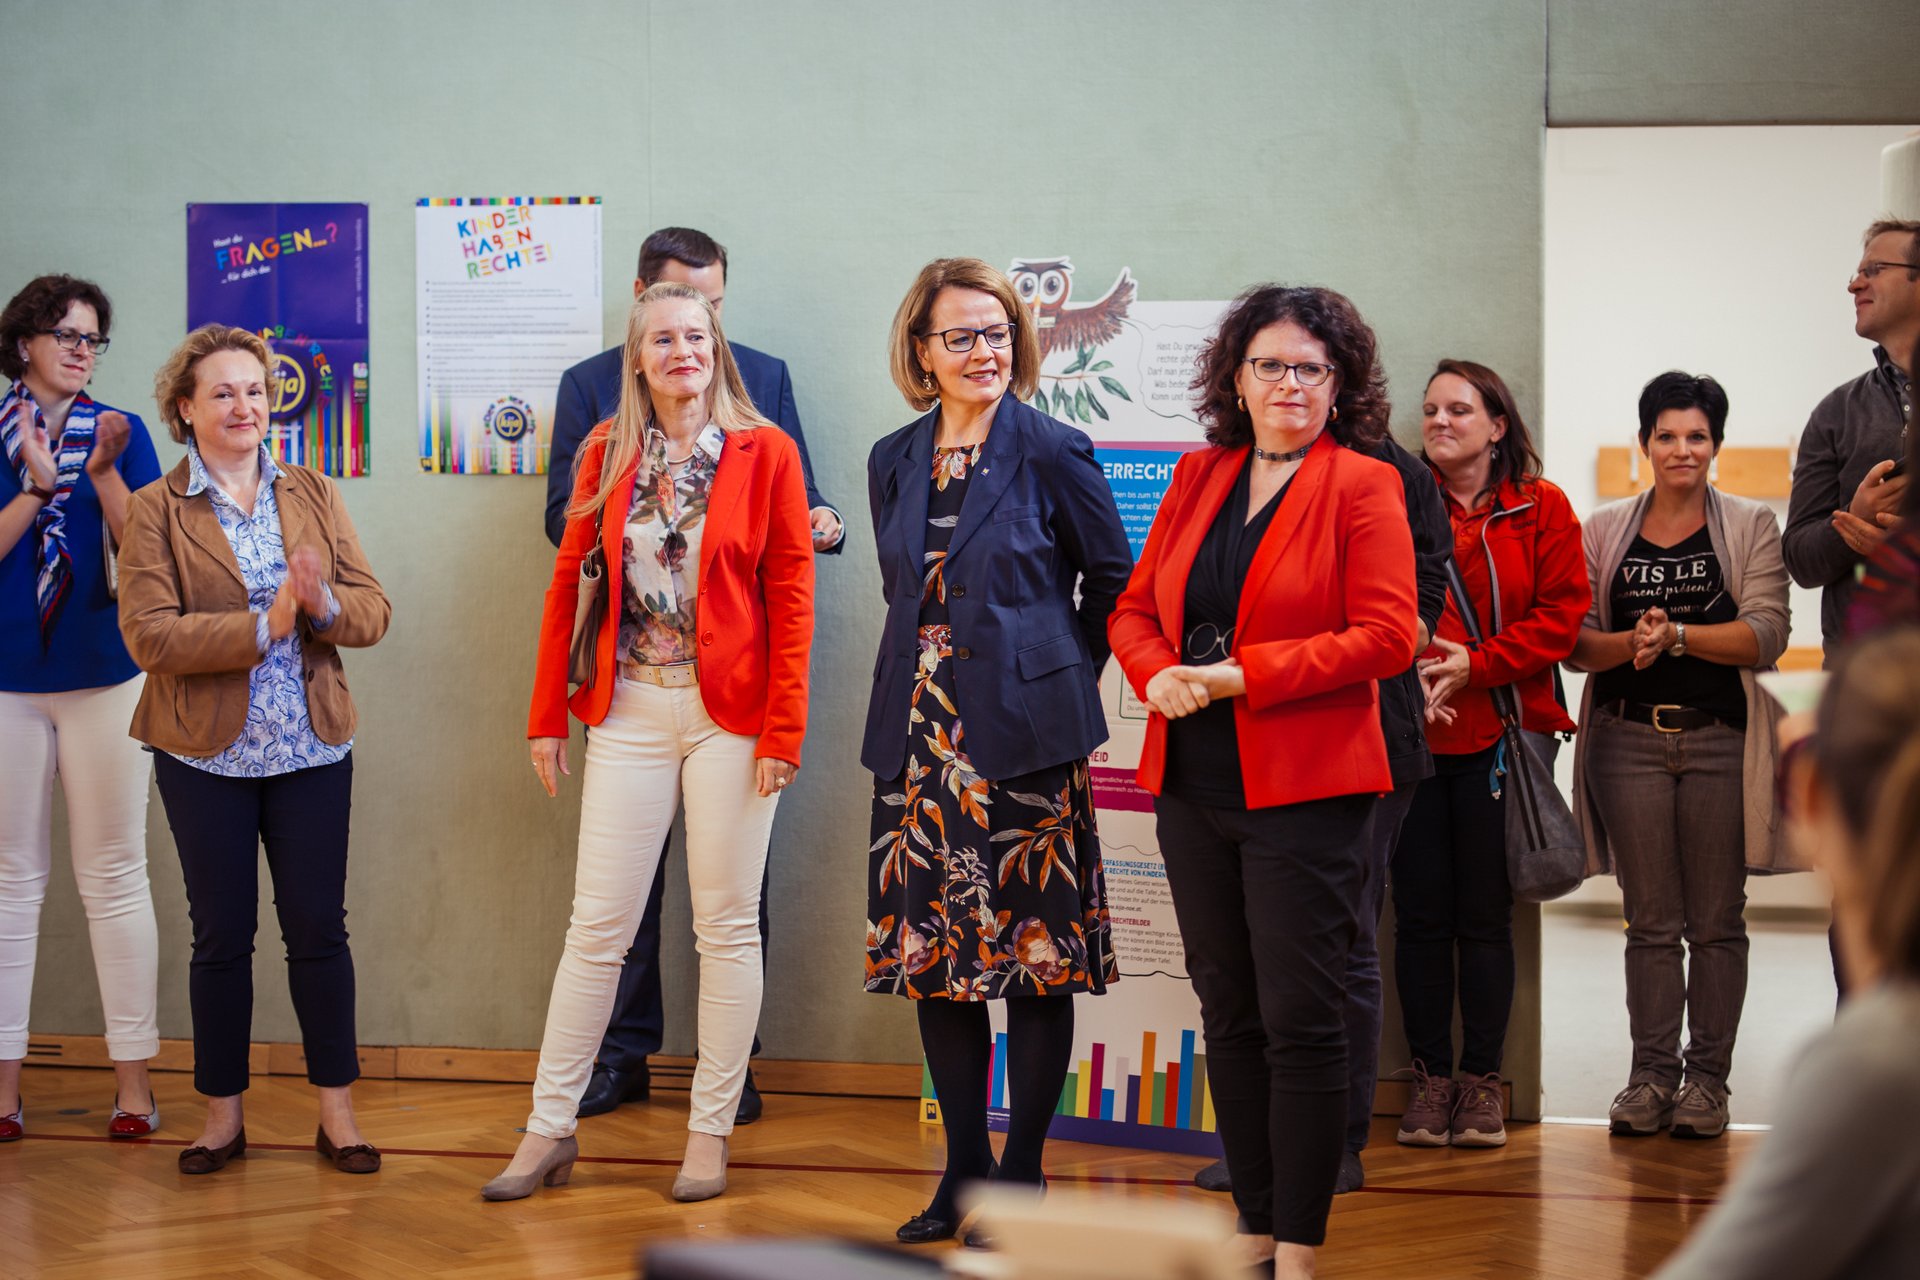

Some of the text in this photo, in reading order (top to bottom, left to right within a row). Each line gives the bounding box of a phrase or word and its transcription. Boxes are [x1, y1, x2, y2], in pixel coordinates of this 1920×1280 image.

[457, 205, 532, 238] KINDER
[462, 226, 532, 258] HABEN
[1171, 392, 1184, 400] und
[1622, 560, 1707, 584] VIS LE
[1109, 867, 1129, 876] RECHTE
